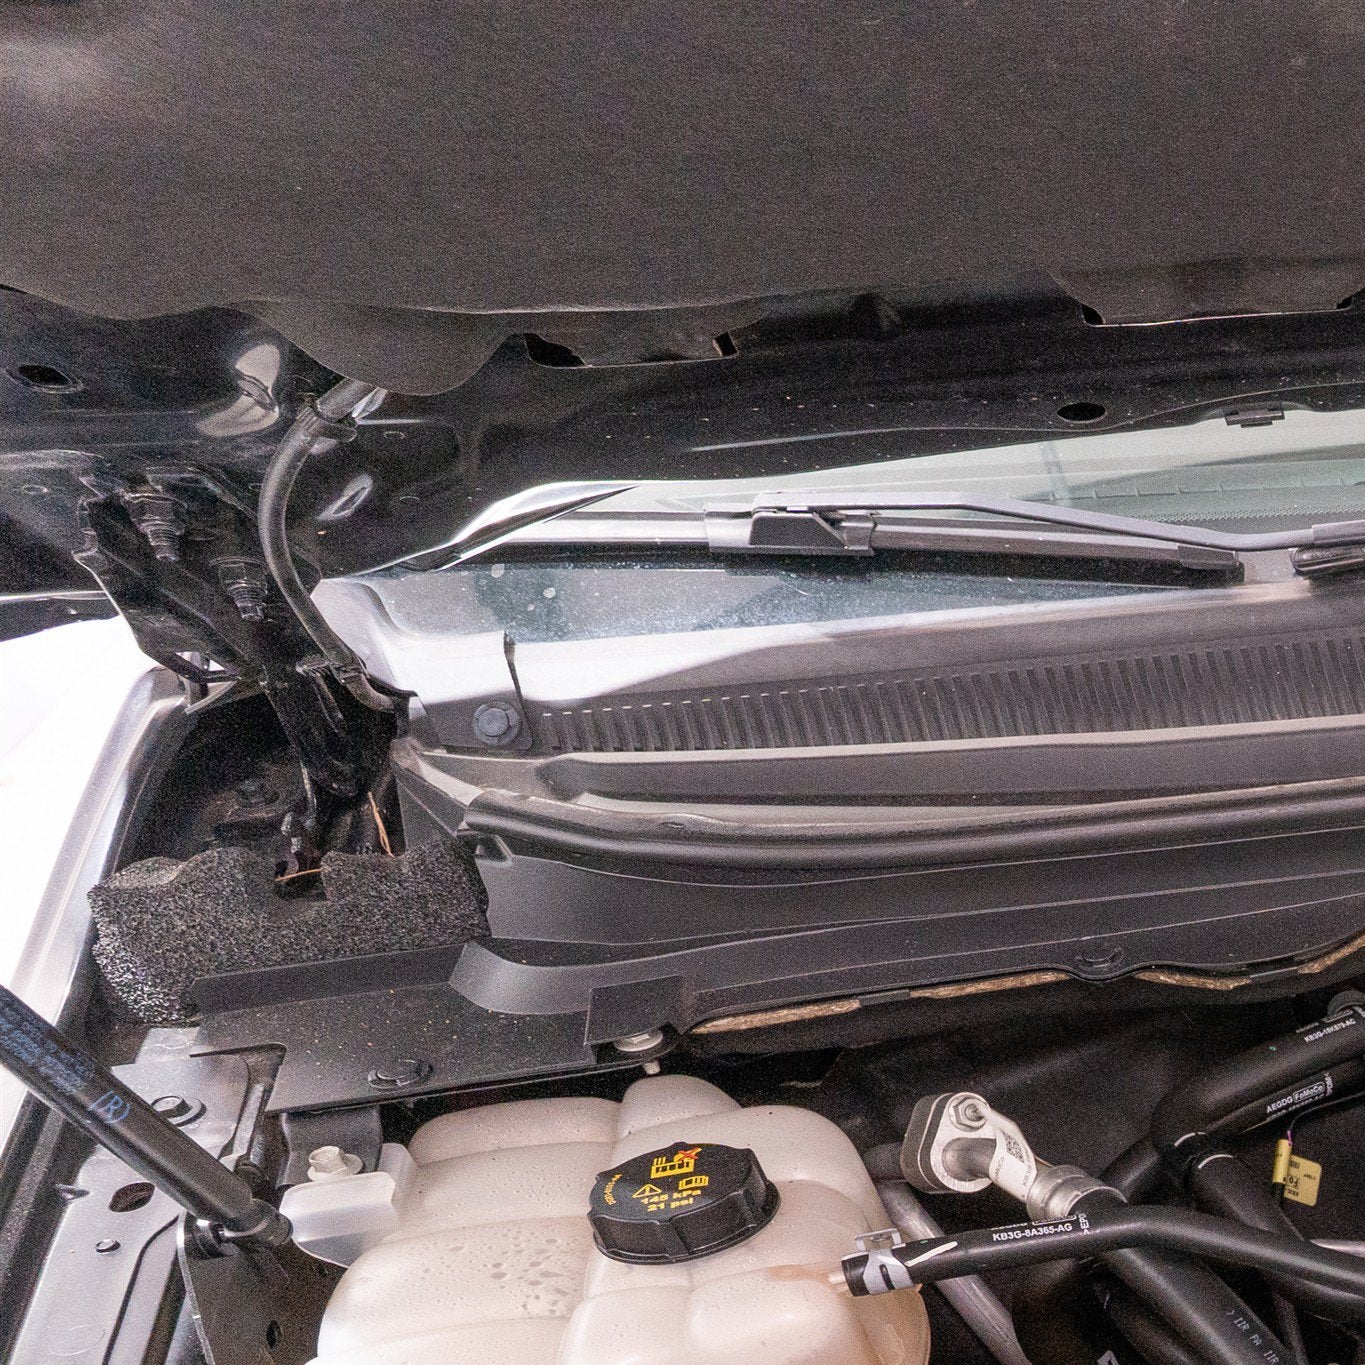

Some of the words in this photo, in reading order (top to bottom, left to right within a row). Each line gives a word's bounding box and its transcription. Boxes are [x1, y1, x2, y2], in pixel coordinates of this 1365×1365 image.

[1294, 1085, 1324, 1100] FoMoCo
[647, 1202, 665, 1212] 21
[670, 1197, 694, 1209] psi
[992, 1223, 1073, 1241] KB3G-8A365-AG
